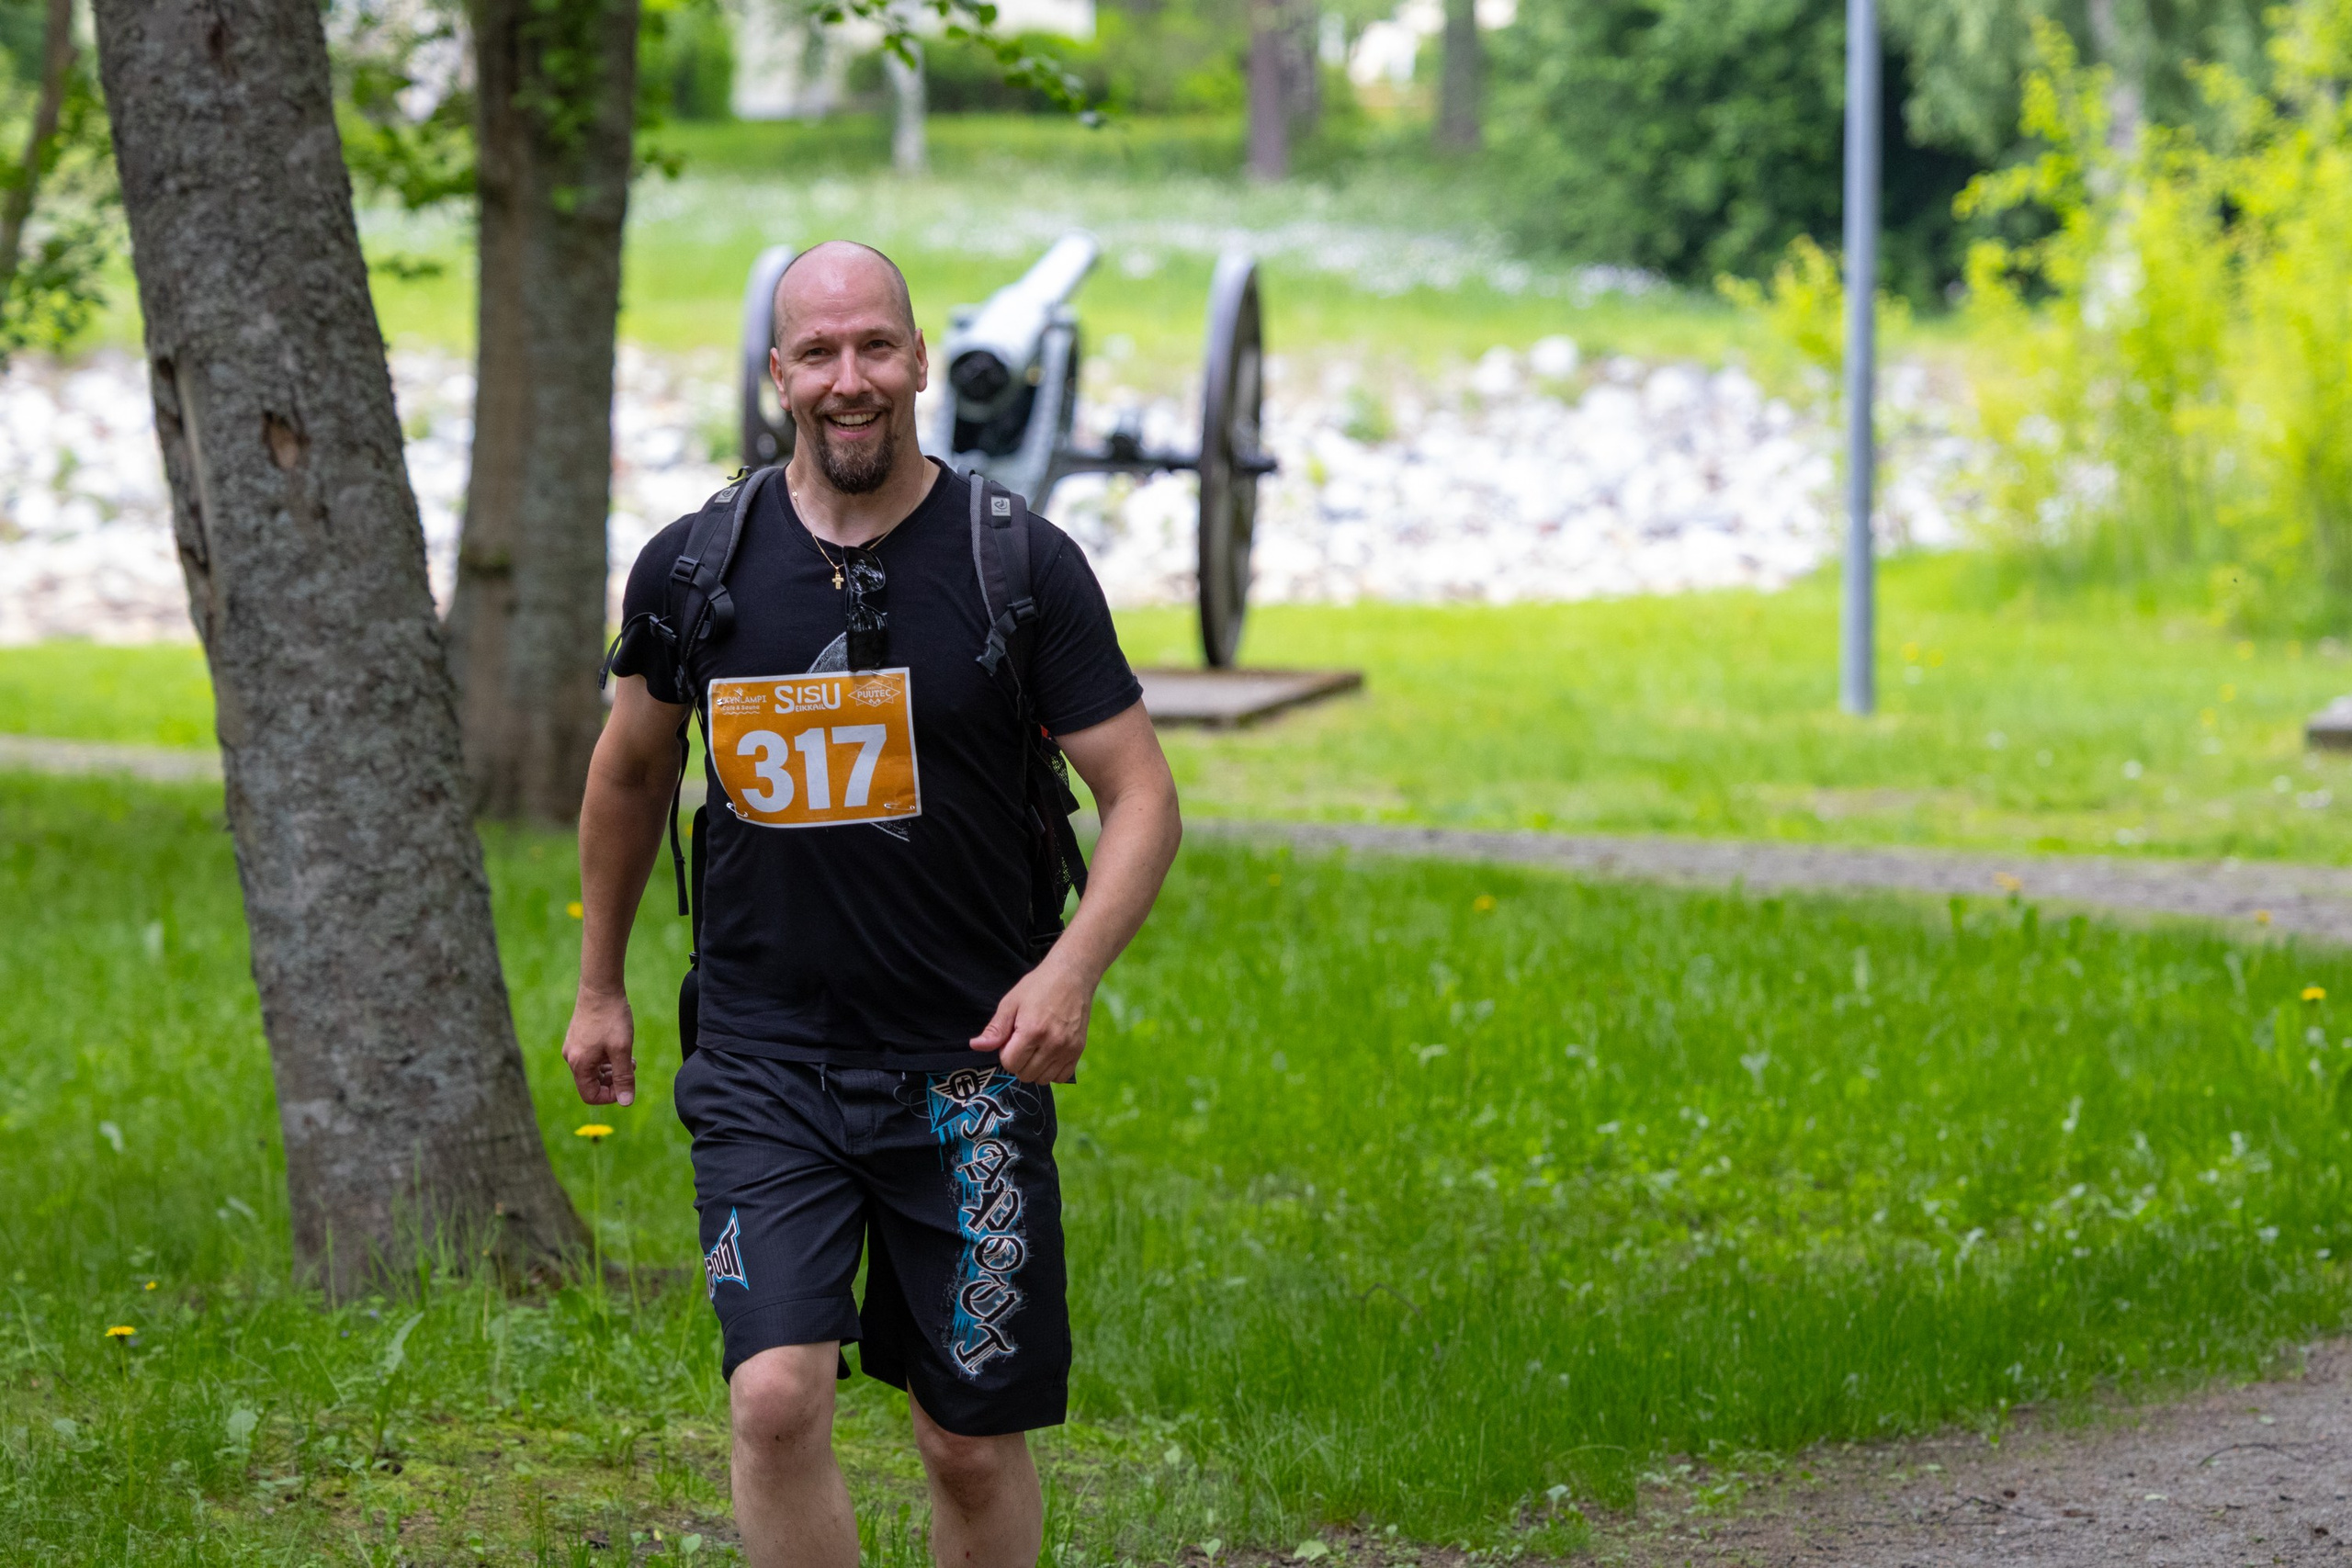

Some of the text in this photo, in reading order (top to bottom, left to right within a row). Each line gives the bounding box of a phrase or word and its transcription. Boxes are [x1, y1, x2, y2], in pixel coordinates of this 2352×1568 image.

[775, 682, 841, 714] SISU
[857, 689, 892, 699] PUUTEC
[737, 724, 887, 813] 317
